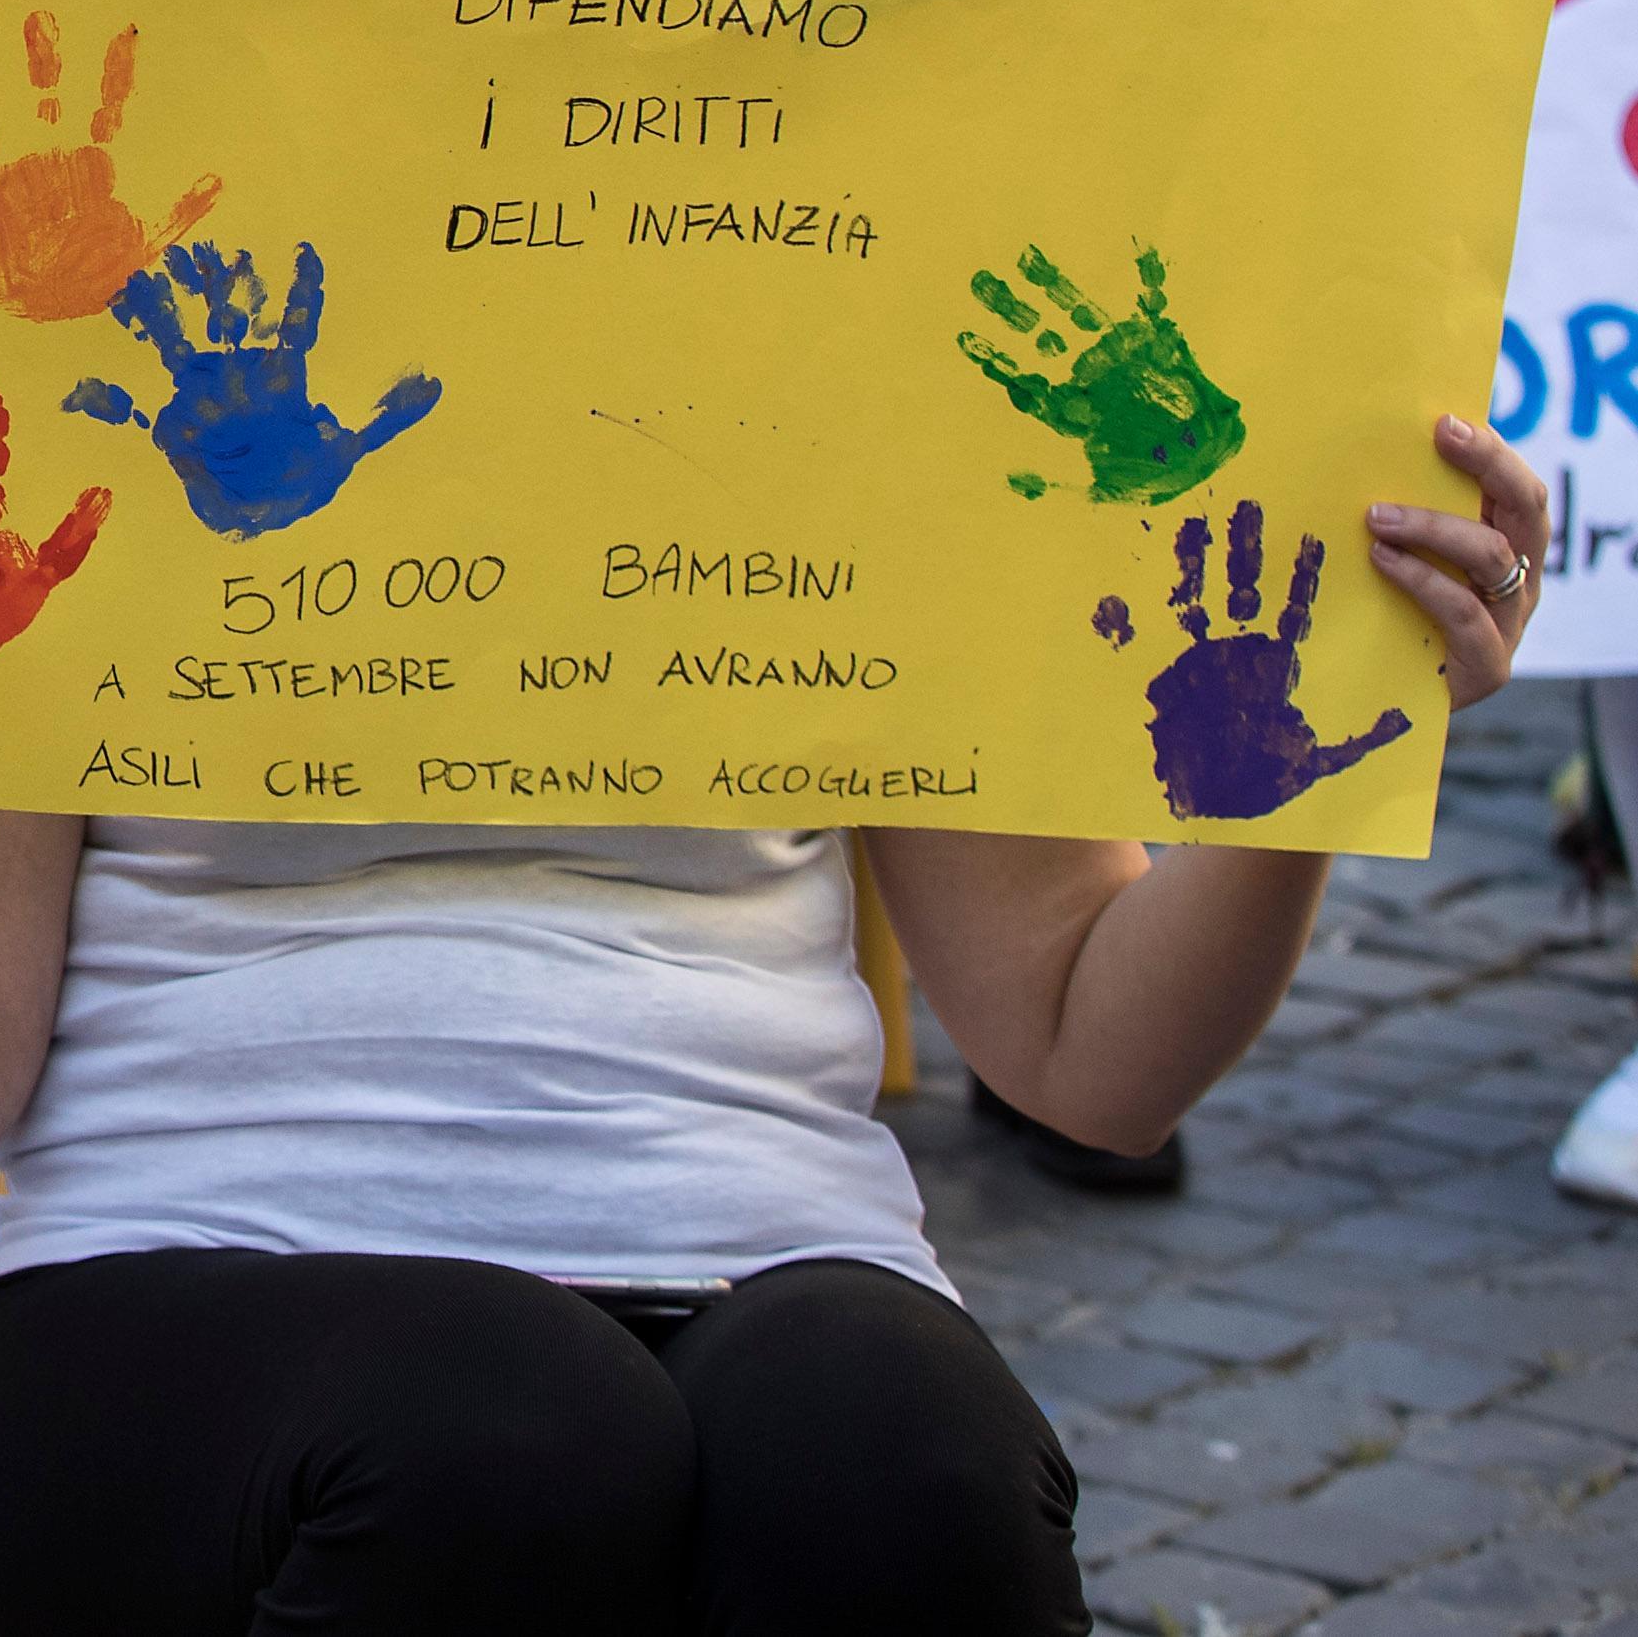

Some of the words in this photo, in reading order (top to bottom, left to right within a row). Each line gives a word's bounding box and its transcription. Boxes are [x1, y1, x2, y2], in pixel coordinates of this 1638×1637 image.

[563, 84, 785, 150] DIRITTI
[444, 189, 597, 253] DELL'
[221, 558, 359, 637] 510
[383, 554, 508, 609] 000
[602, 541, 856, 602] BAMBINI
[93, 662, 128, 703] A
[166, 654, 457, 702] SETTEMBRE
[519, 650, 614, 693] NON
[656, 645, 898, 691] AVRANNO
[77, 738, 203, 790] ASILI
[263, 758, 363, 799] CHE
[417, 757, 665, 799] POTRANNO
